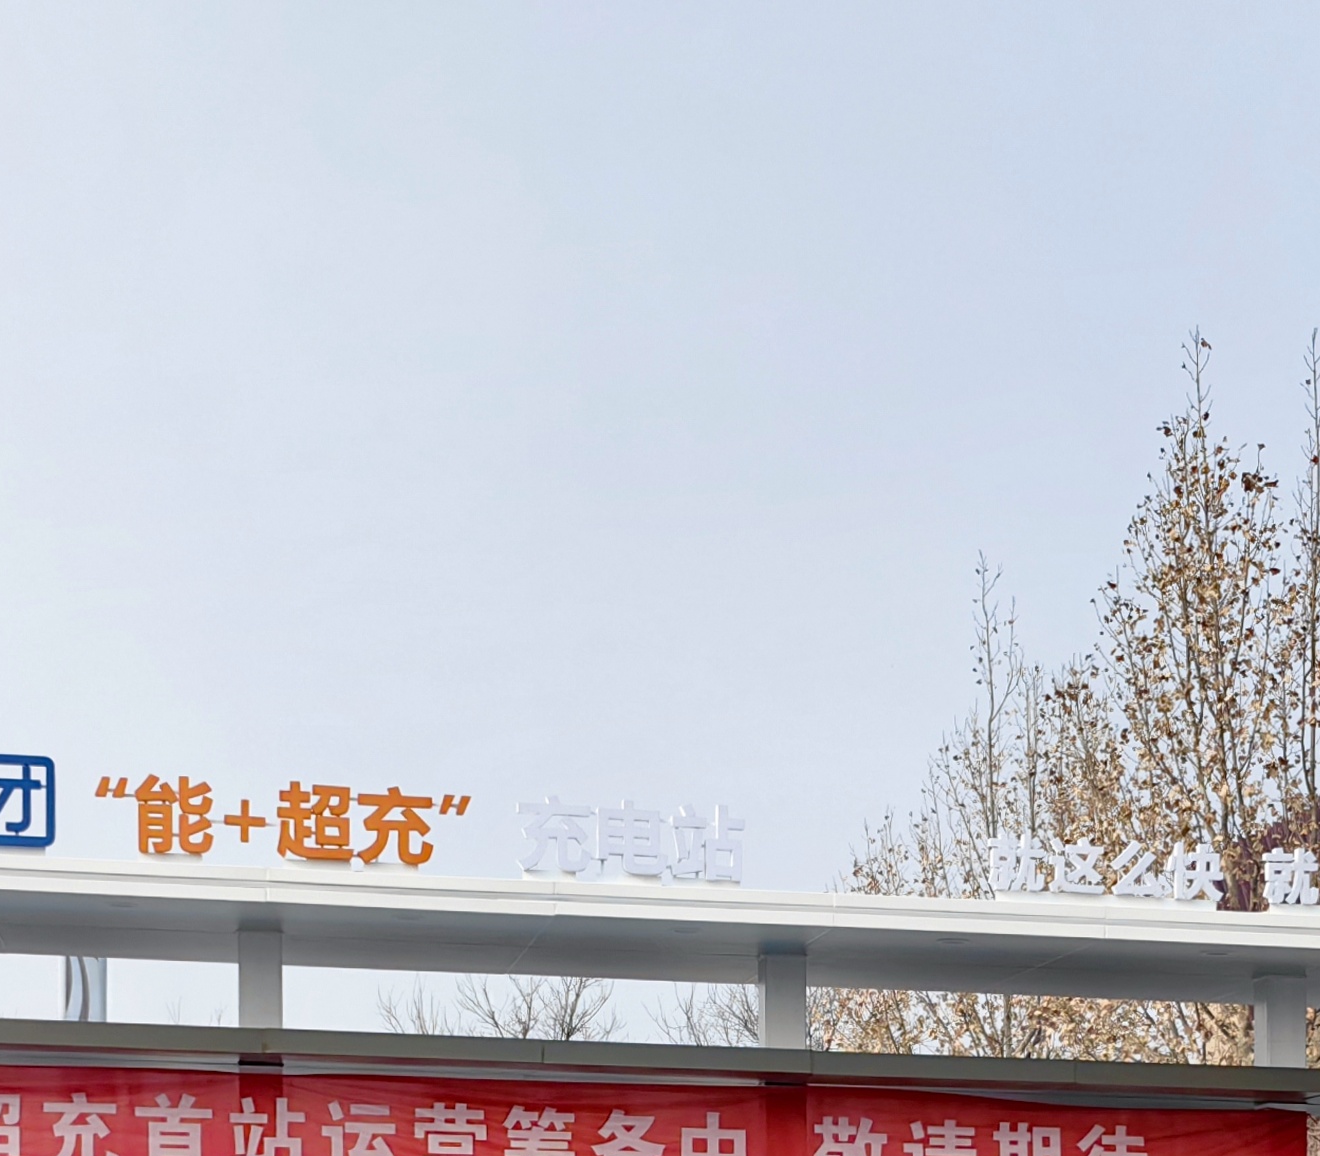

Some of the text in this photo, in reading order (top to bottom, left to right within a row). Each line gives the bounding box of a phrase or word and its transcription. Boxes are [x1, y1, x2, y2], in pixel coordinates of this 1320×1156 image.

[516, 795, 744, 882] 充电站
[987, 833, 1224, 902] 就这么快
